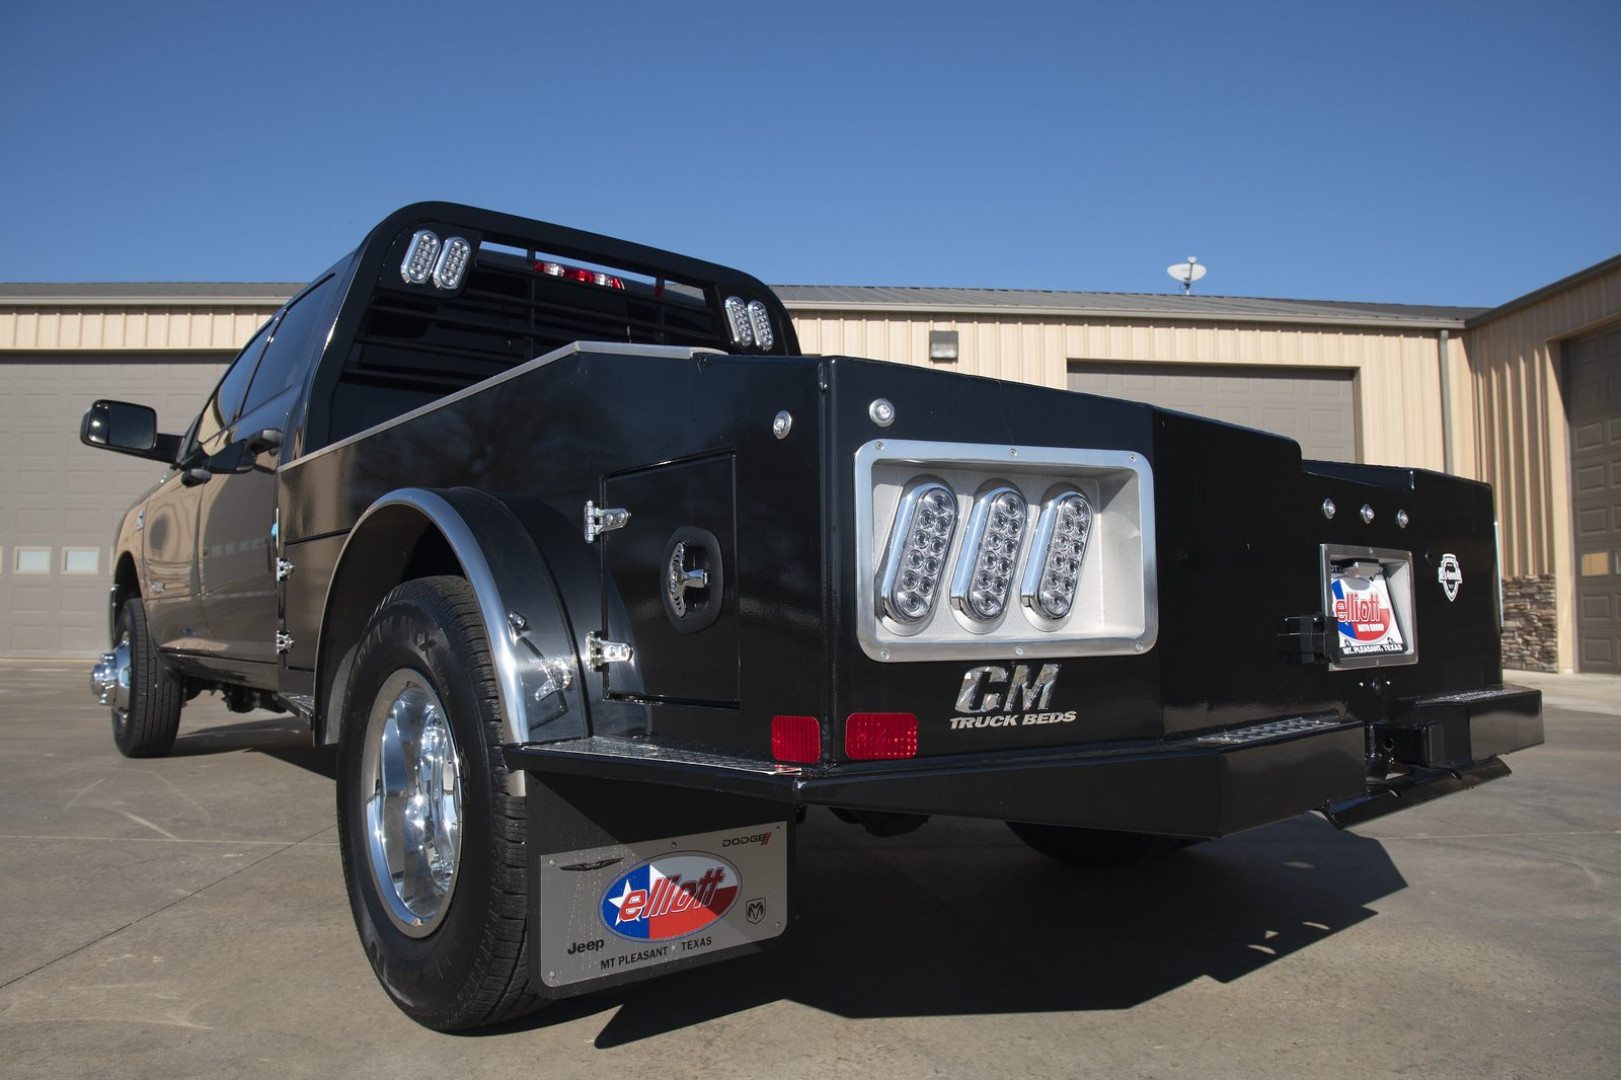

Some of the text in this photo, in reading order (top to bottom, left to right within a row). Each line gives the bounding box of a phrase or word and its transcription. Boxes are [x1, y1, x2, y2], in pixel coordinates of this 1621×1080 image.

[1335, 591, 1381, 622] elliott
[1384, 643, 1403, 652] TEXAS
[954, 663, 1061, 714] CM
[950, 711, 1077, 730] TRUCK BEDS
[722, 833, 767, 847] DODGE
[618, 866, 725, 922] elliott
[567, 939, 605, 955] Jeep
[600, 936, 712, 971] MT PLEASANT TEXAS
